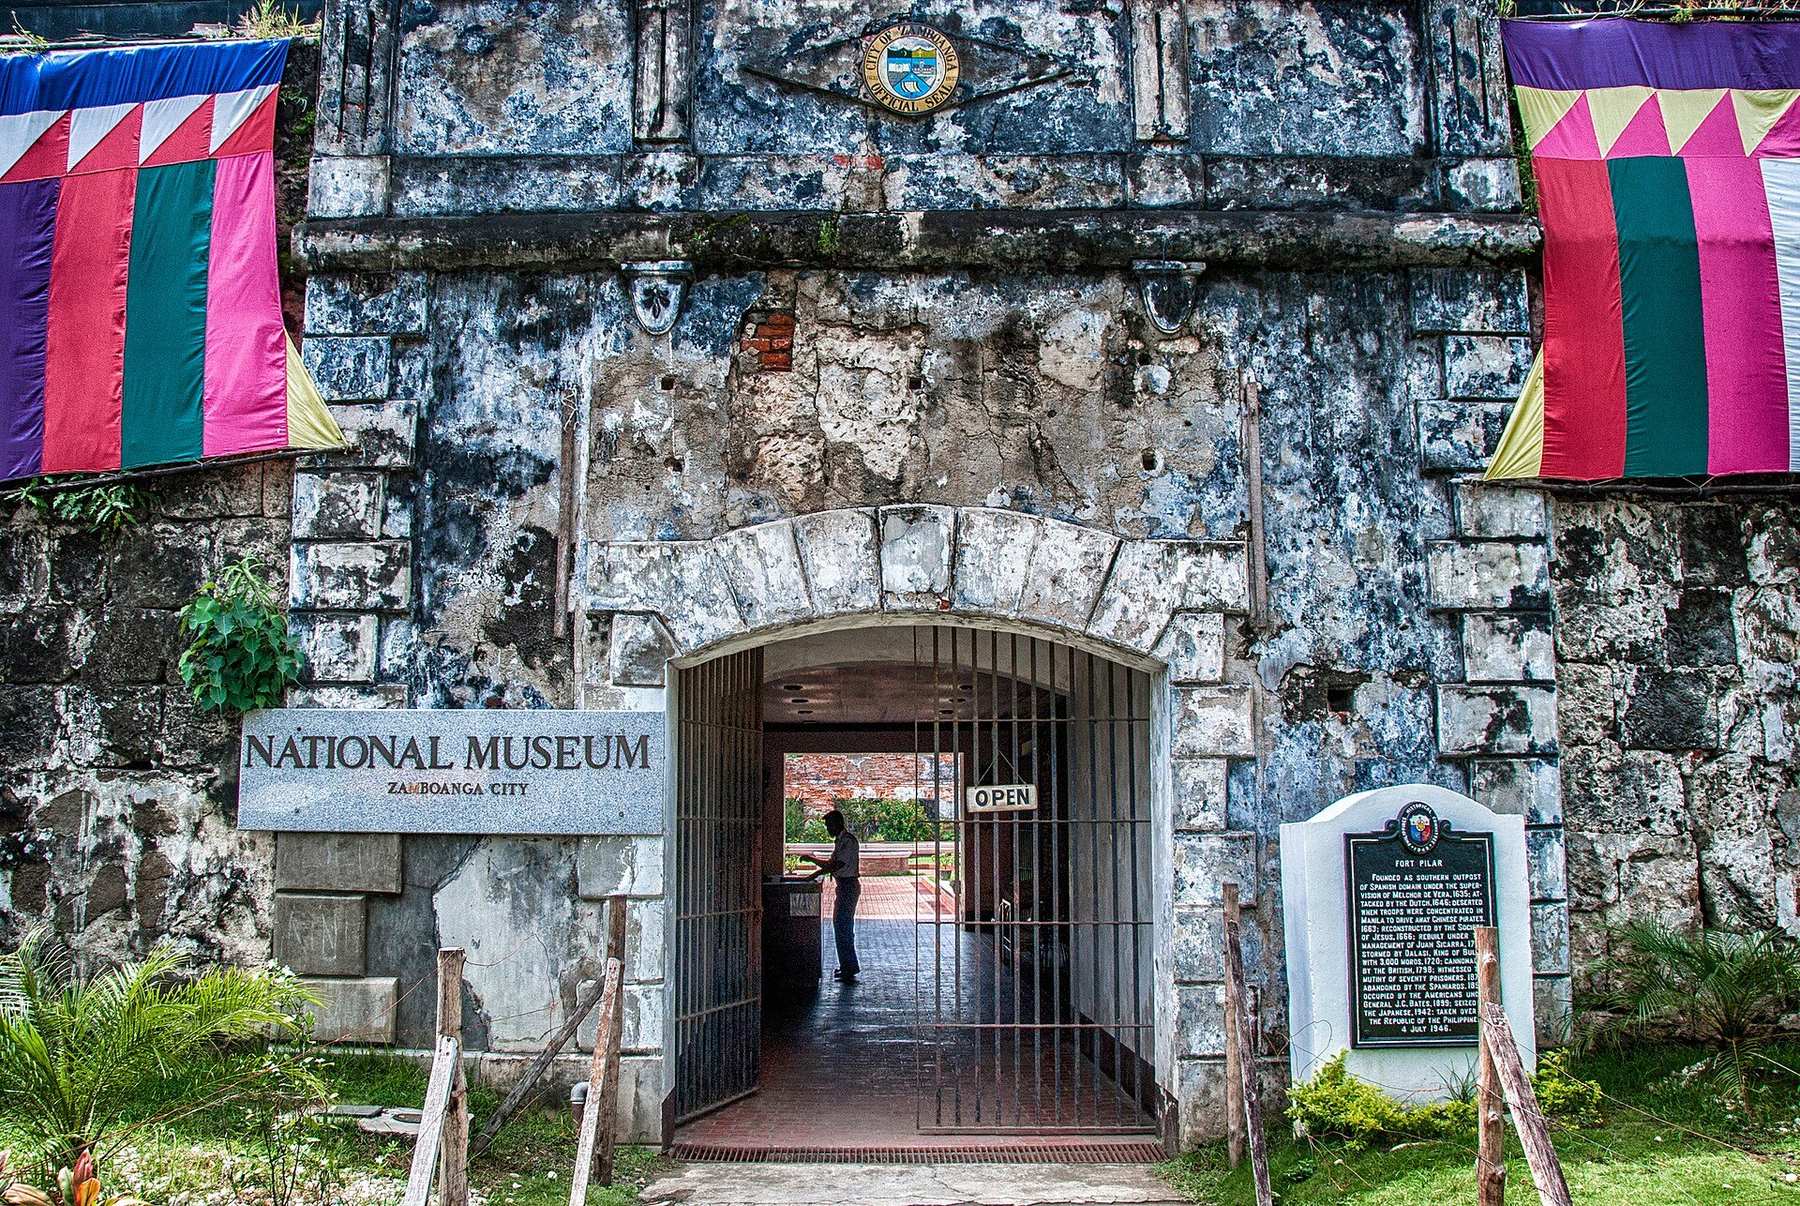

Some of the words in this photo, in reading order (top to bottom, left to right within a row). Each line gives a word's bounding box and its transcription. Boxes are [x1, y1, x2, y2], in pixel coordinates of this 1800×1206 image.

[866, 45, 881, 71] CITY
[879, 31, 893, 44] OF
[871, 82, 918, 111] OFFICIAL
[925, 84, 953, 108] SEAL
[245, 734, 454, 769] NATIONAL
[464, 734, 650, 770] MUSEUM
[387, 782, 484, 795] ZAMBOANGA
[490, 783, 529, 795] CITY
[975, 788, 1029, 807] OPEN
[1424, 991, 1462, 999] AMERICANS
